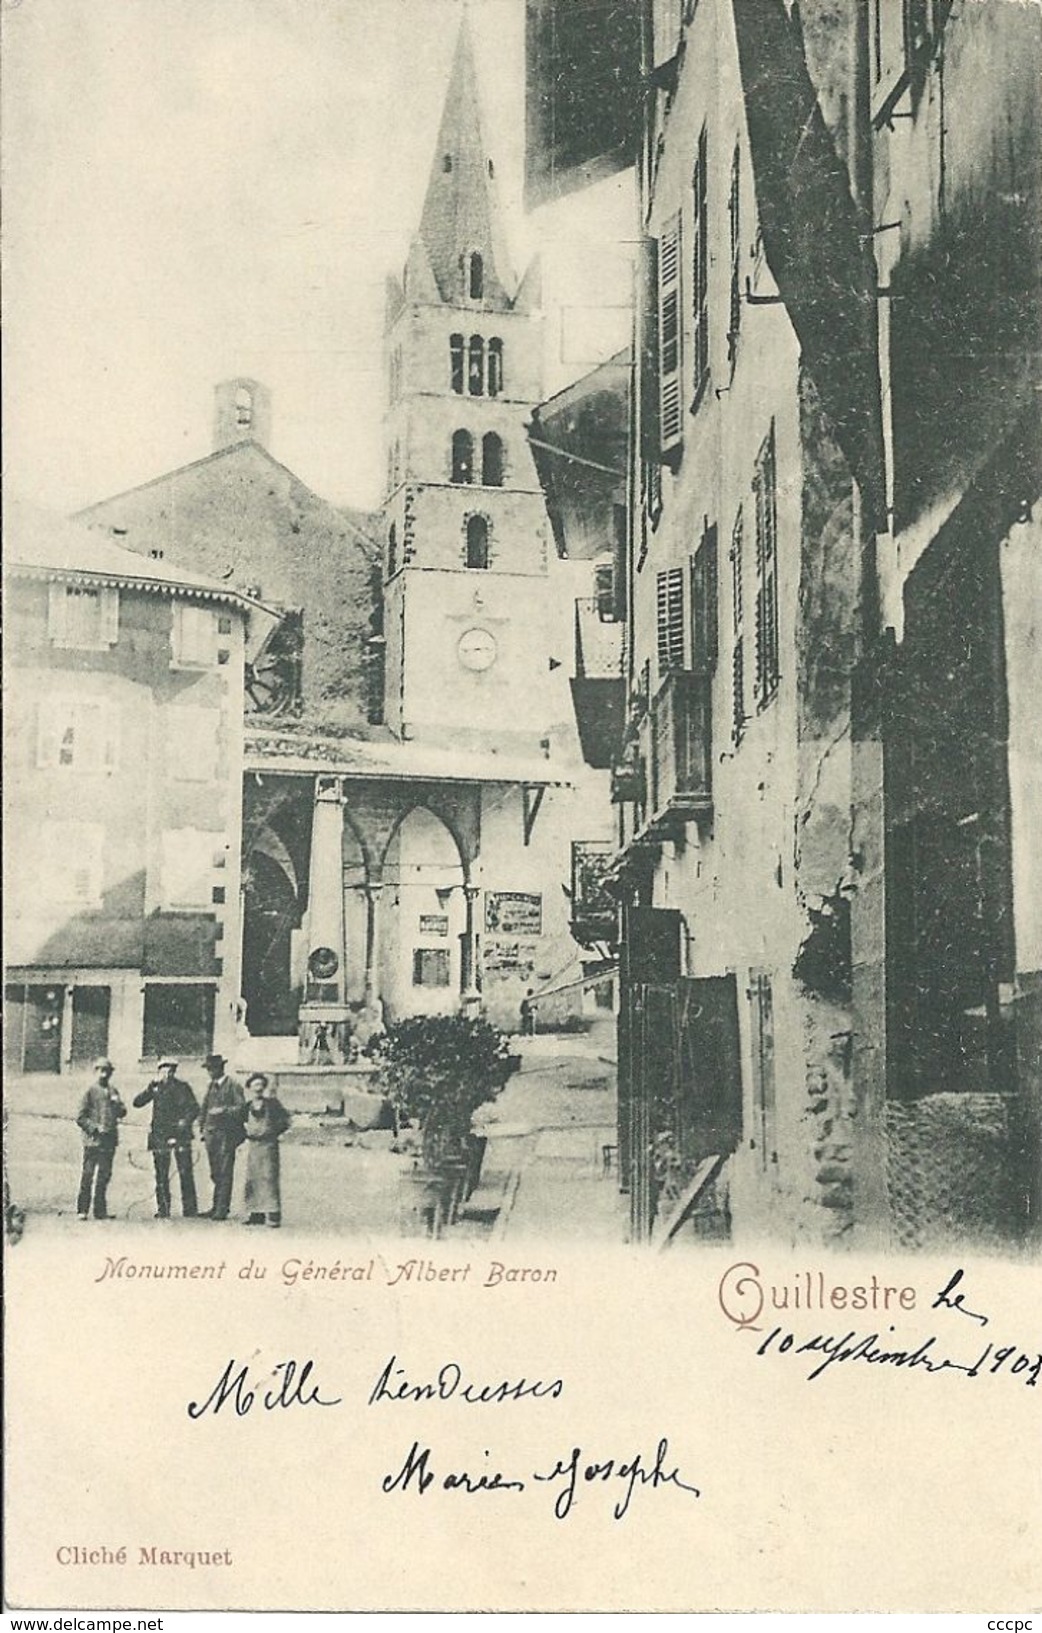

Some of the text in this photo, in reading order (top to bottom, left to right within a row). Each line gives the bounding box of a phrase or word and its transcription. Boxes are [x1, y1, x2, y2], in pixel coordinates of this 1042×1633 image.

[95, 1256, 559, 1288] Monument du Général Albert Baron
[719, 1262, 917, 1332] Quillestre
[188, 1359, 342, 1420] Mille
[55, 1545, 234, 1570] Cliché Marquet
